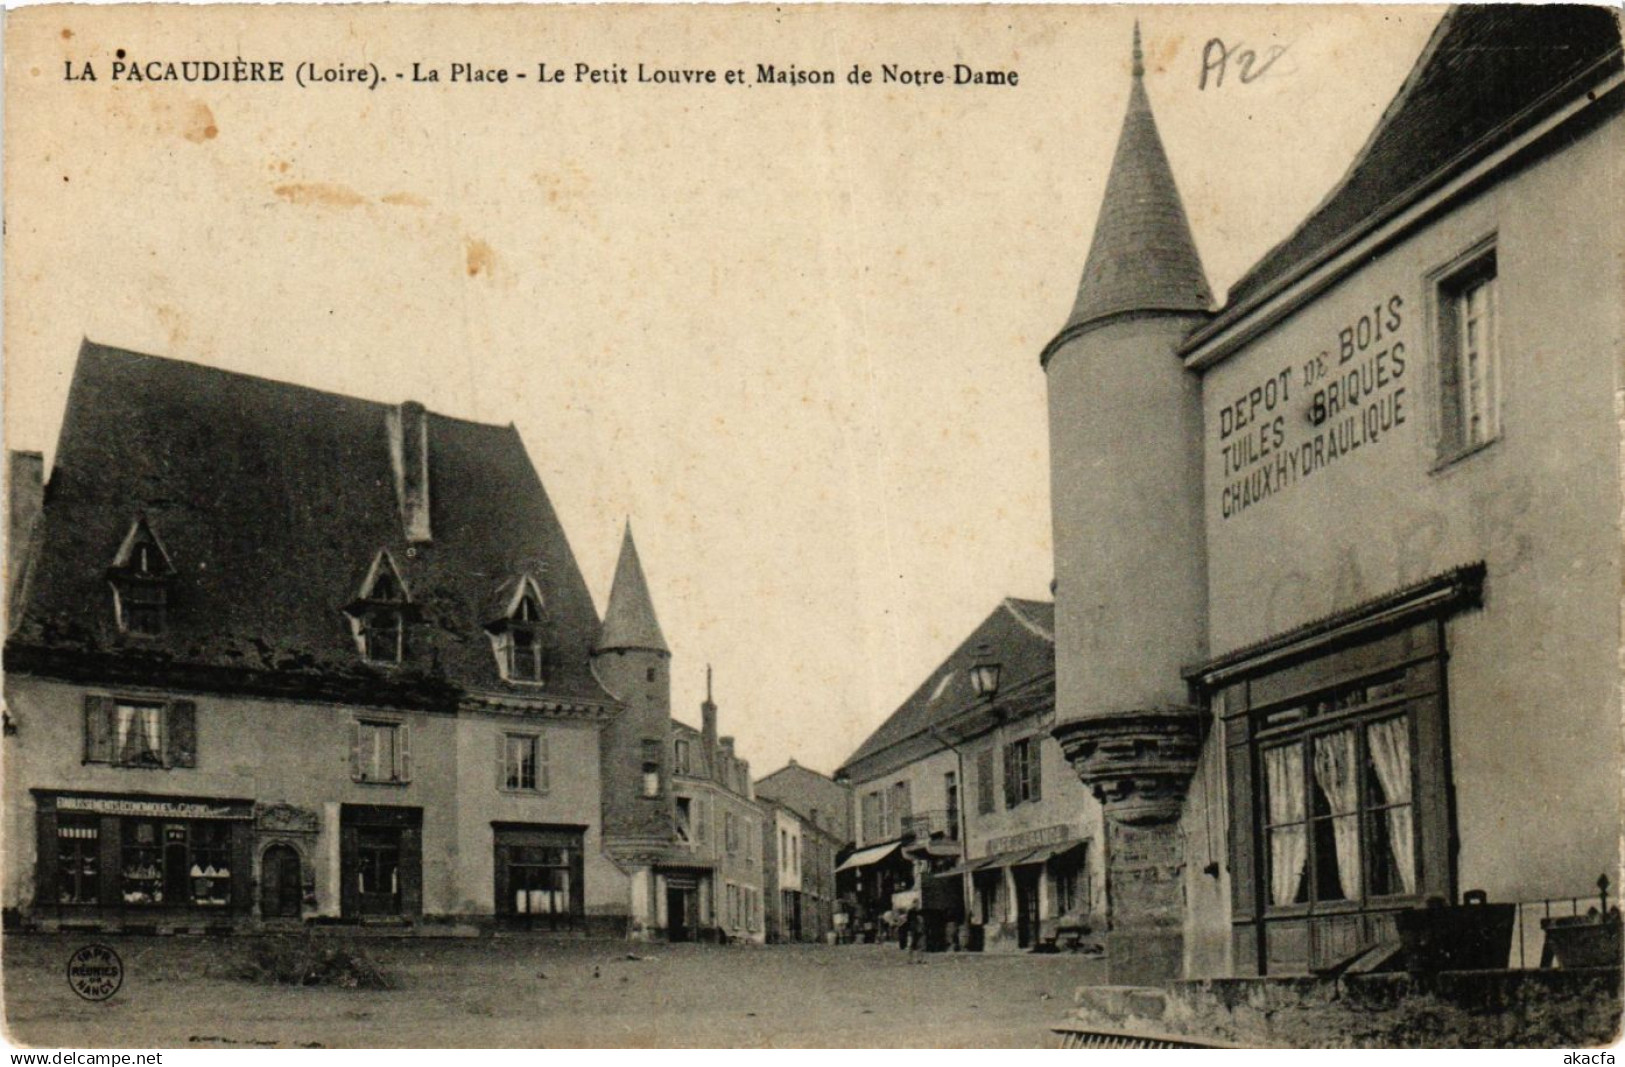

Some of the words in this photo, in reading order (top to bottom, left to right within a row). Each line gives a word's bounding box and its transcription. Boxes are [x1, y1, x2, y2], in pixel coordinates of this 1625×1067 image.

[1220, 367, 1292, 440] DEPOT
[1338, 295, 1404, 365] BOIS
[1222, 415, 1284, 477] TUILES
[1311, 341, 1406, 427] BRIQUES
